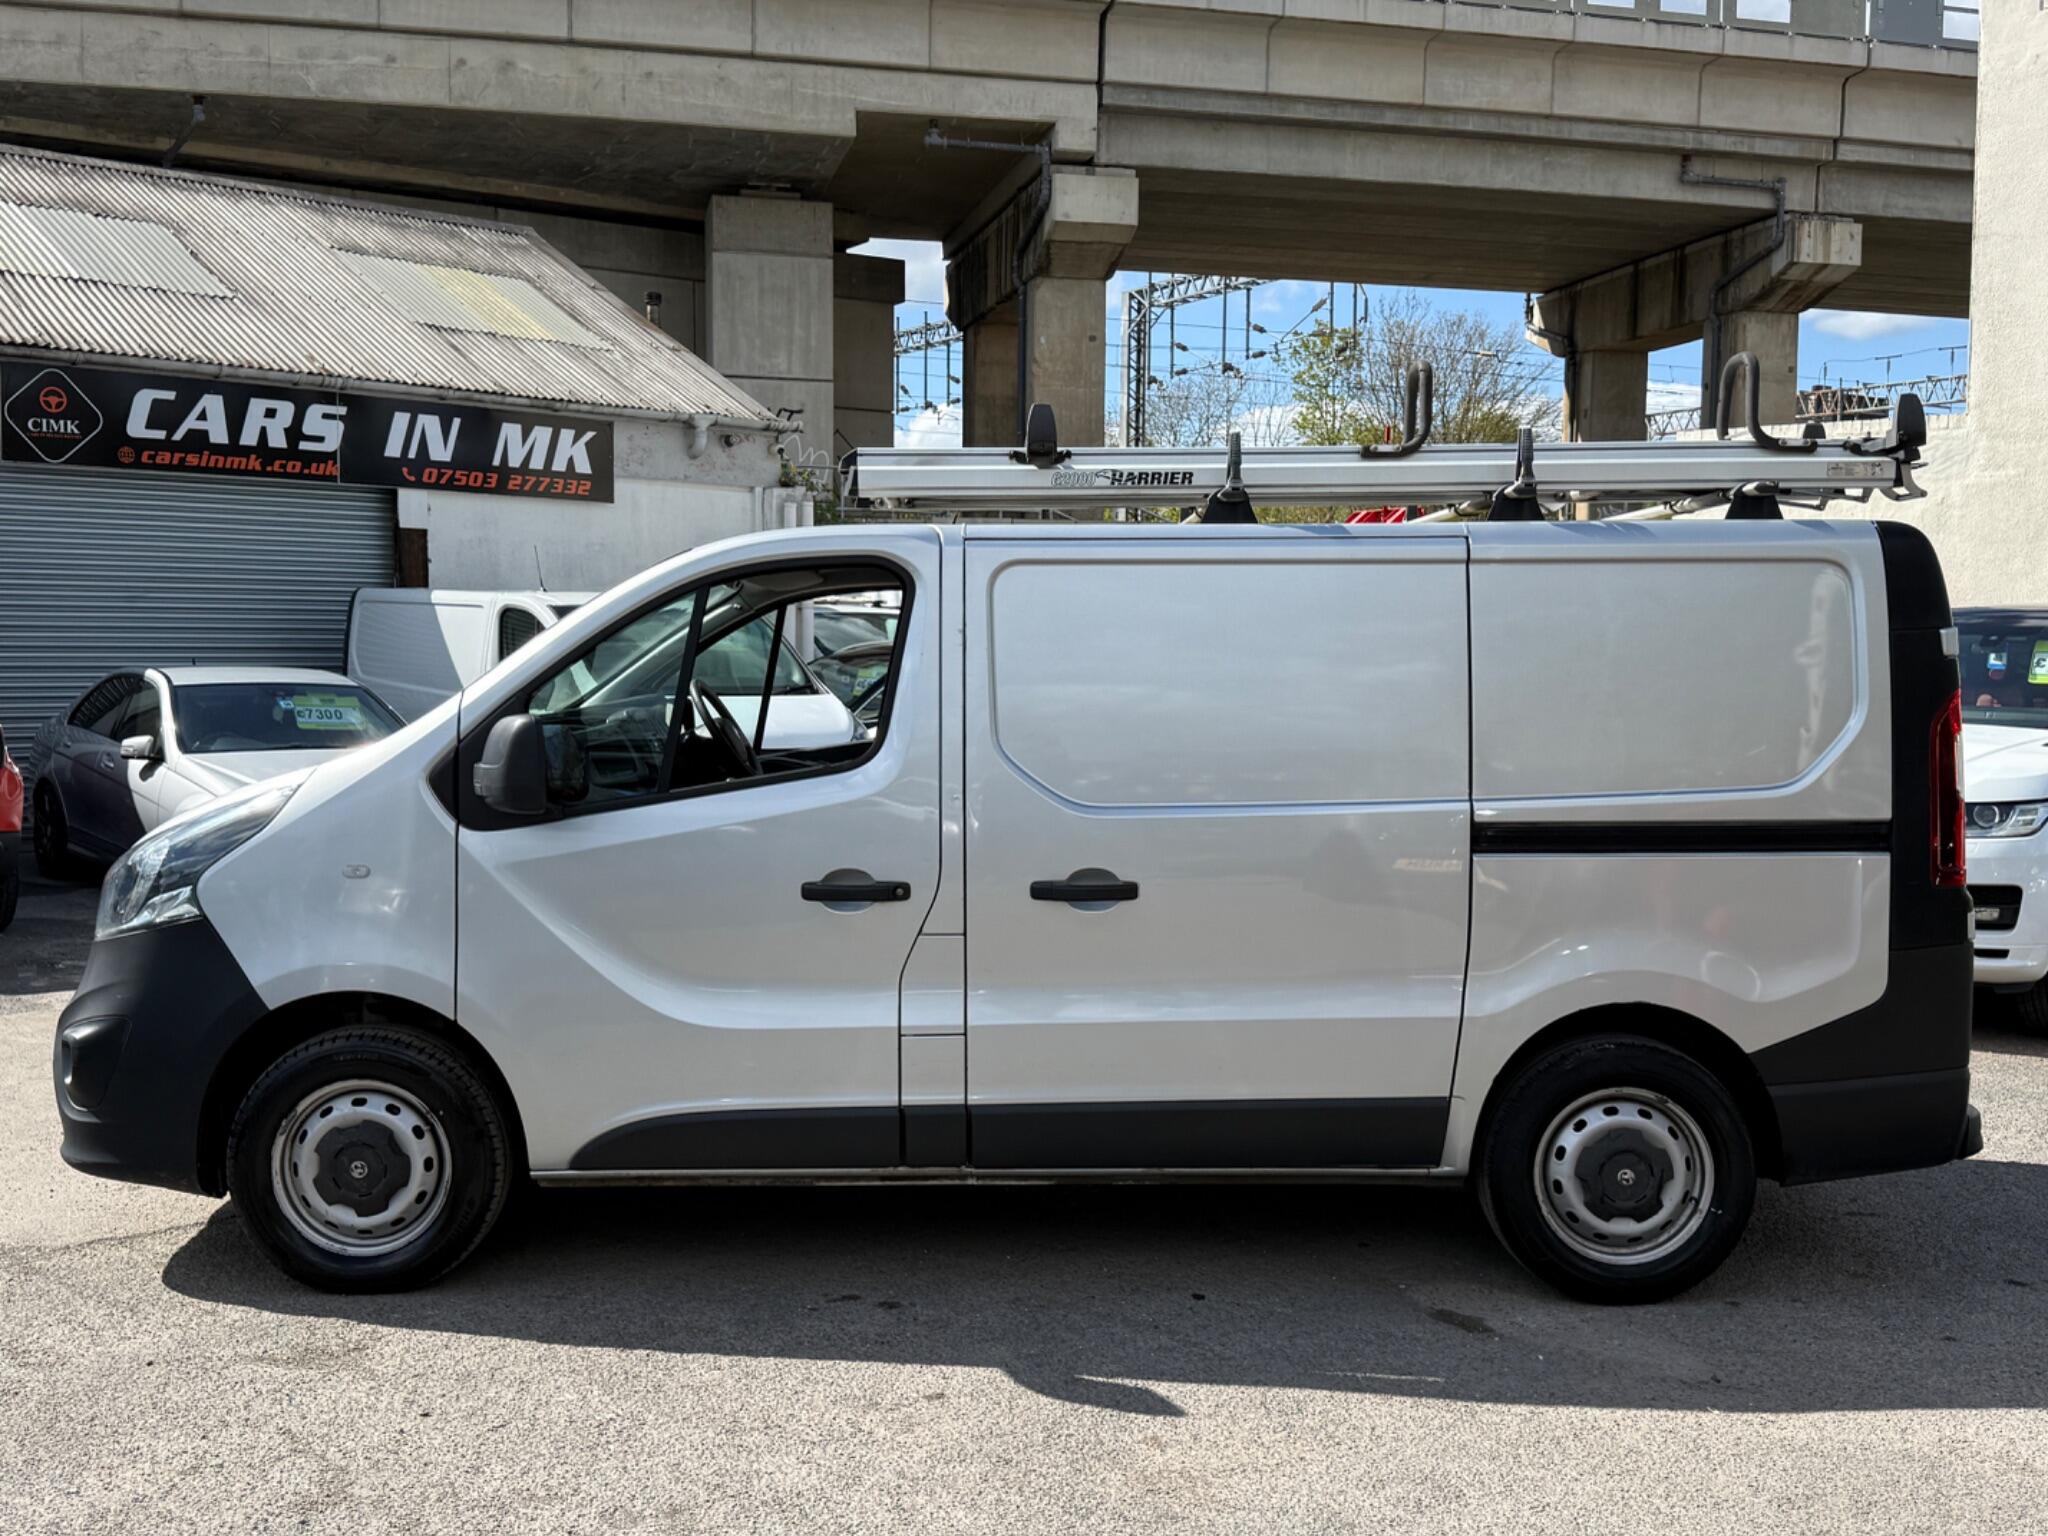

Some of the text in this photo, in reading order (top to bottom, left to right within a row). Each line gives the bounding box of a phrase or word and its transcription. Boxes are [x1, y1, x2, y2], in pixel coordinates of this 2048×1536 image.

[27, 417, 80, 434] CIMK
[126, 388, 598, 475] CARS IN MK
[141, 450, 340, 477] carsinmk.co.uk
[422, 468, 592, 496] 07503 277332
[1110, 471, 1194, 486] HARRIER
